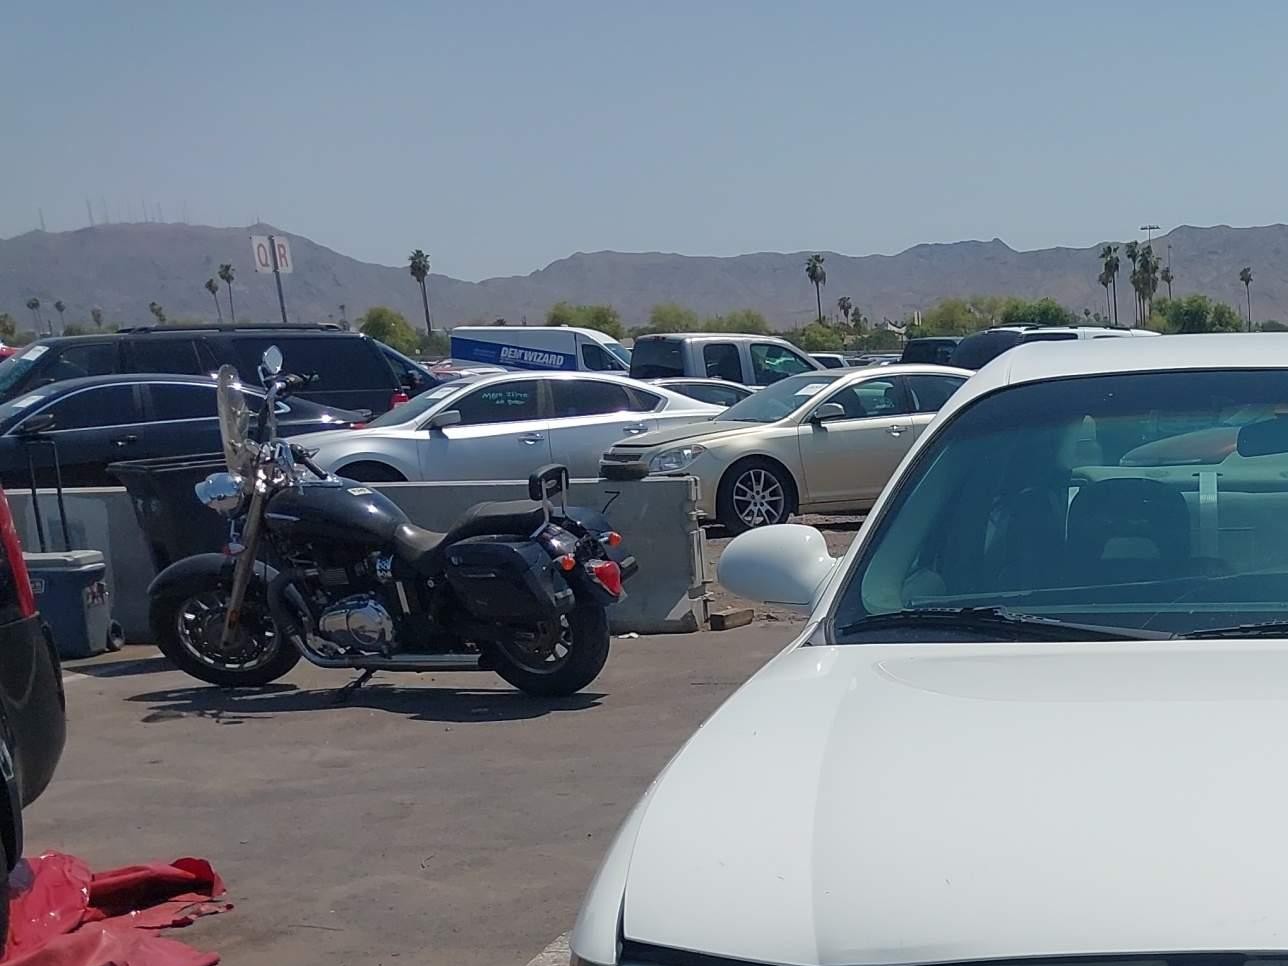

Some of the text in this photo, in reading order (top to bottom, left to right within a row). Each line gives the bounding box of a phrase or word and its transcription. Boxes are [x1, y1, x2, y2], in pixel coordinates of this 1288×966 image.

[257, 243, 270, 267] Q
[277, 243, 288, 267] R
[524, 350, 565, 366] WIZARD
[602, 490, 620, 514] 7
